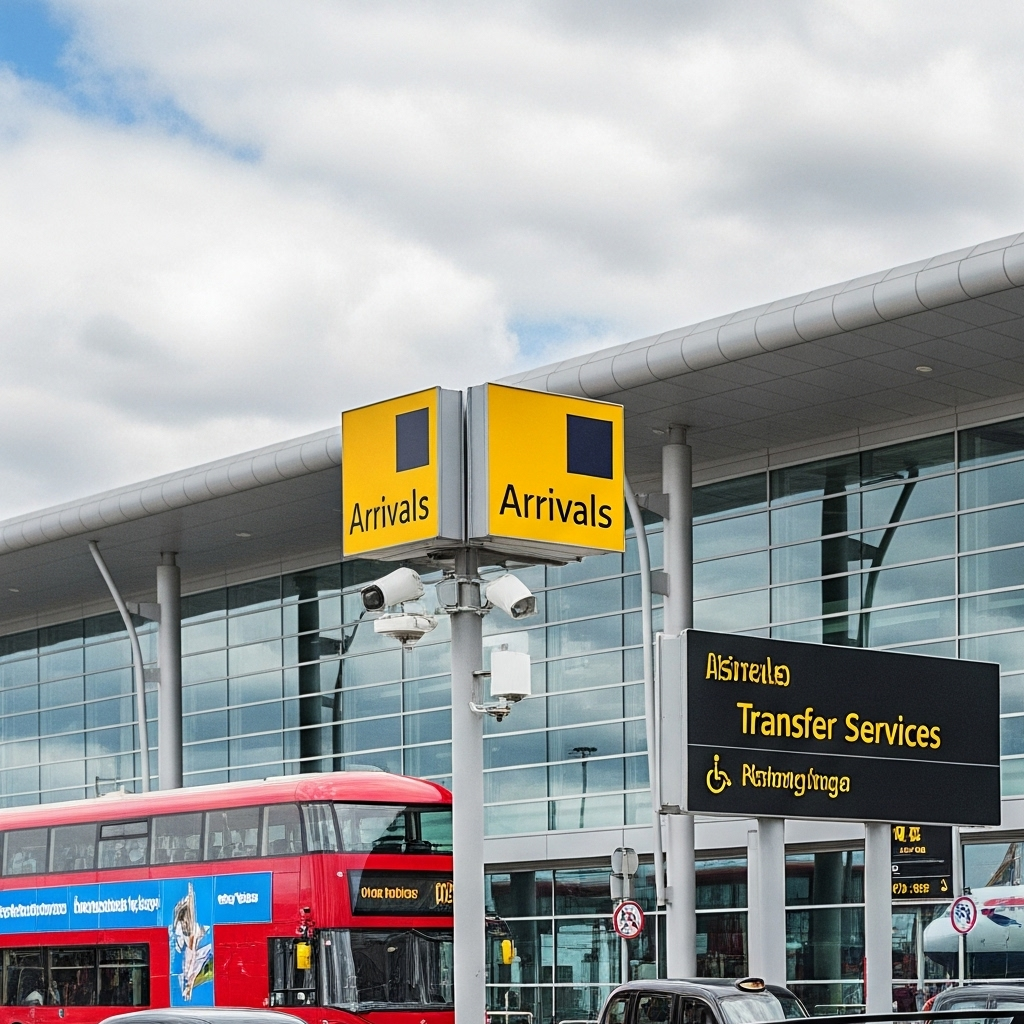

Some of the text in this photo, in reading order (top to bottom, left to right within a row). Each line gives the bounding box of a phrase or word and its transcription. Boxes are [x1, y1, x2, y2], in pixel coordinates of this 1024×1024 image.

[349, 488, 430, 535] Arrivals
[498, 483, 613, 529] Arrivals
[736, 702, 942, 750] Transfer Services
